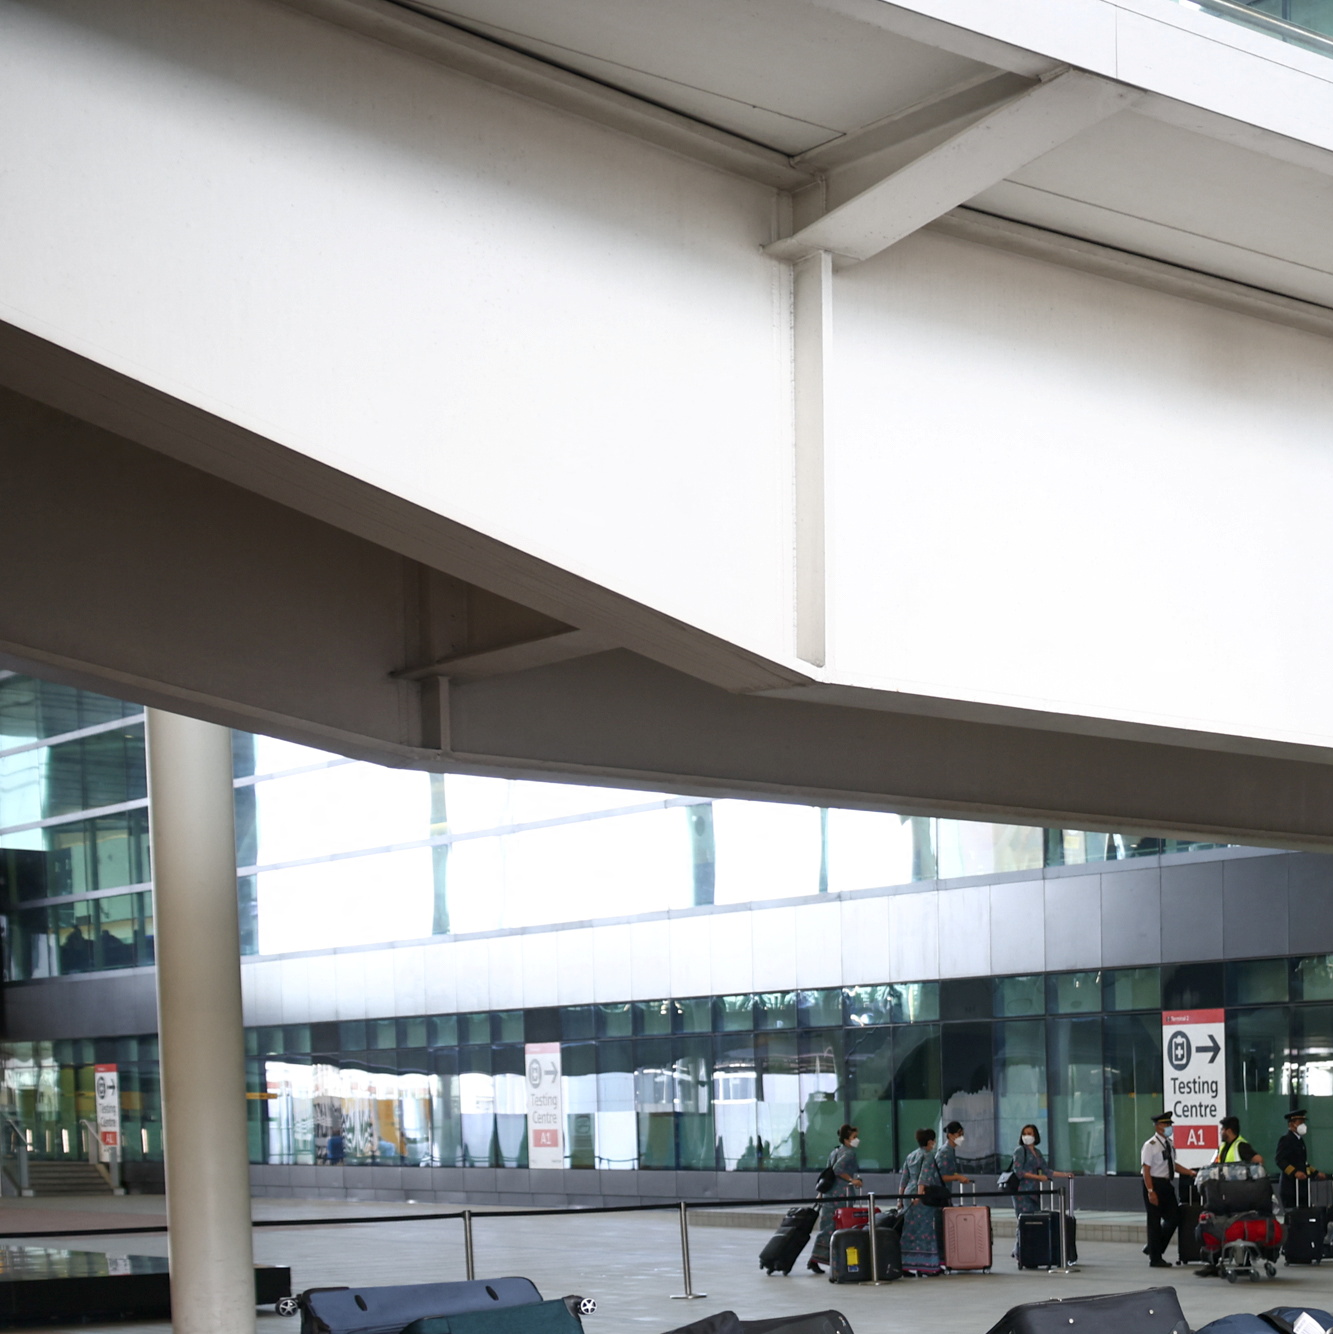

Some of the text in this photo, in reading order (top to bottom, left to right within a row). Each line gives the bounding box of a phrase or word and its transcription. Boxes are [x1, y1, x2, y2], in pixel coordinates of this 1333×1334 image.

[1170, 1076, 1218, 1098] Testing
[530, 1092, 558, 1109] Testing
[1173, 1100, 1217, 1118] Centre
[532, 1111, 558, 1124] Centre
[540, 1132, 552, 1145] A1
[1187, 1128, 1205, 1146] A1
